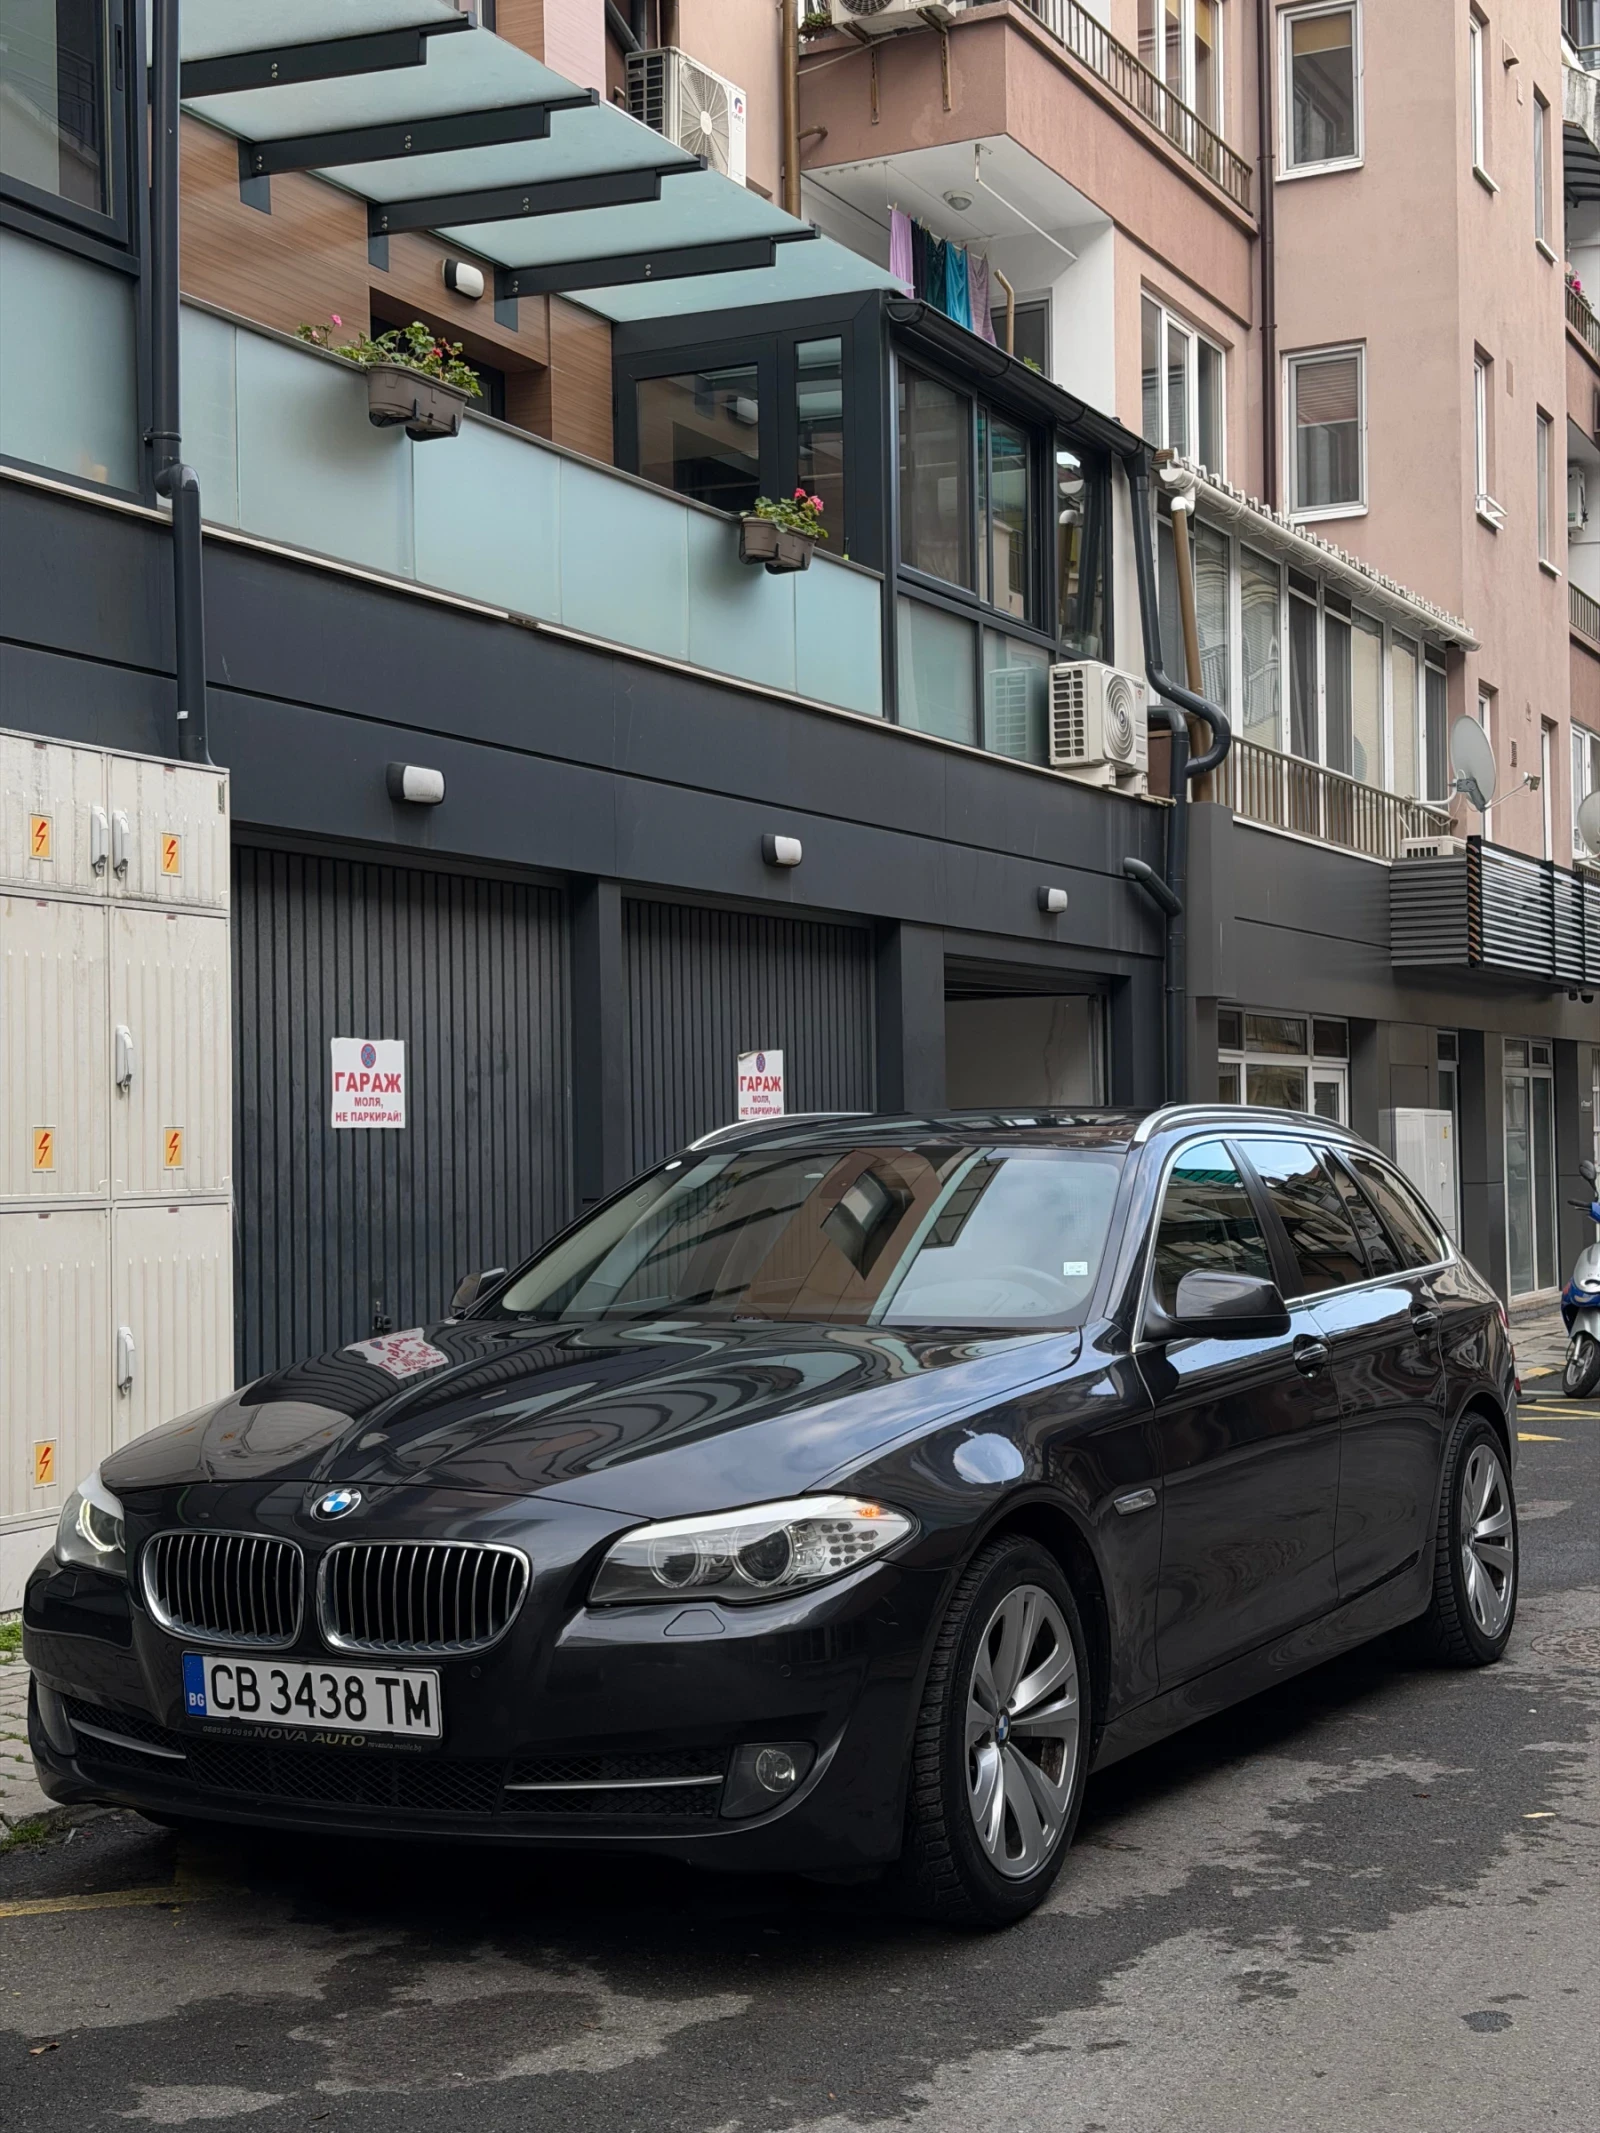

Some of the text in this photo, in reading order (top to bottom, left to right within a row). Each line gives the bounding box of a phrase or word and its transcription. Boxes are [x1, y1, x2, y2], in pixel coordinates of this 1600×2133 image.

[335, 1071, 401, 1093] ГАРАЖ
[740, 1076, 782, 1092] ГАРАЖ
[354, 1097, 383, 1109] МОЛЯ,
[752, 1095, 770, 1104] МОЛЯ,
[335, 1110, 402, 1122] НЕ ПАРКИРАЙ!
[740, 1107, 749, 1115] НЕ
[188, 1692, 205, 1707] BG
[210, 1664, 431, 1728] CB 3438 TM
[253, 1726, 366, 1747] NOVA AUTO
